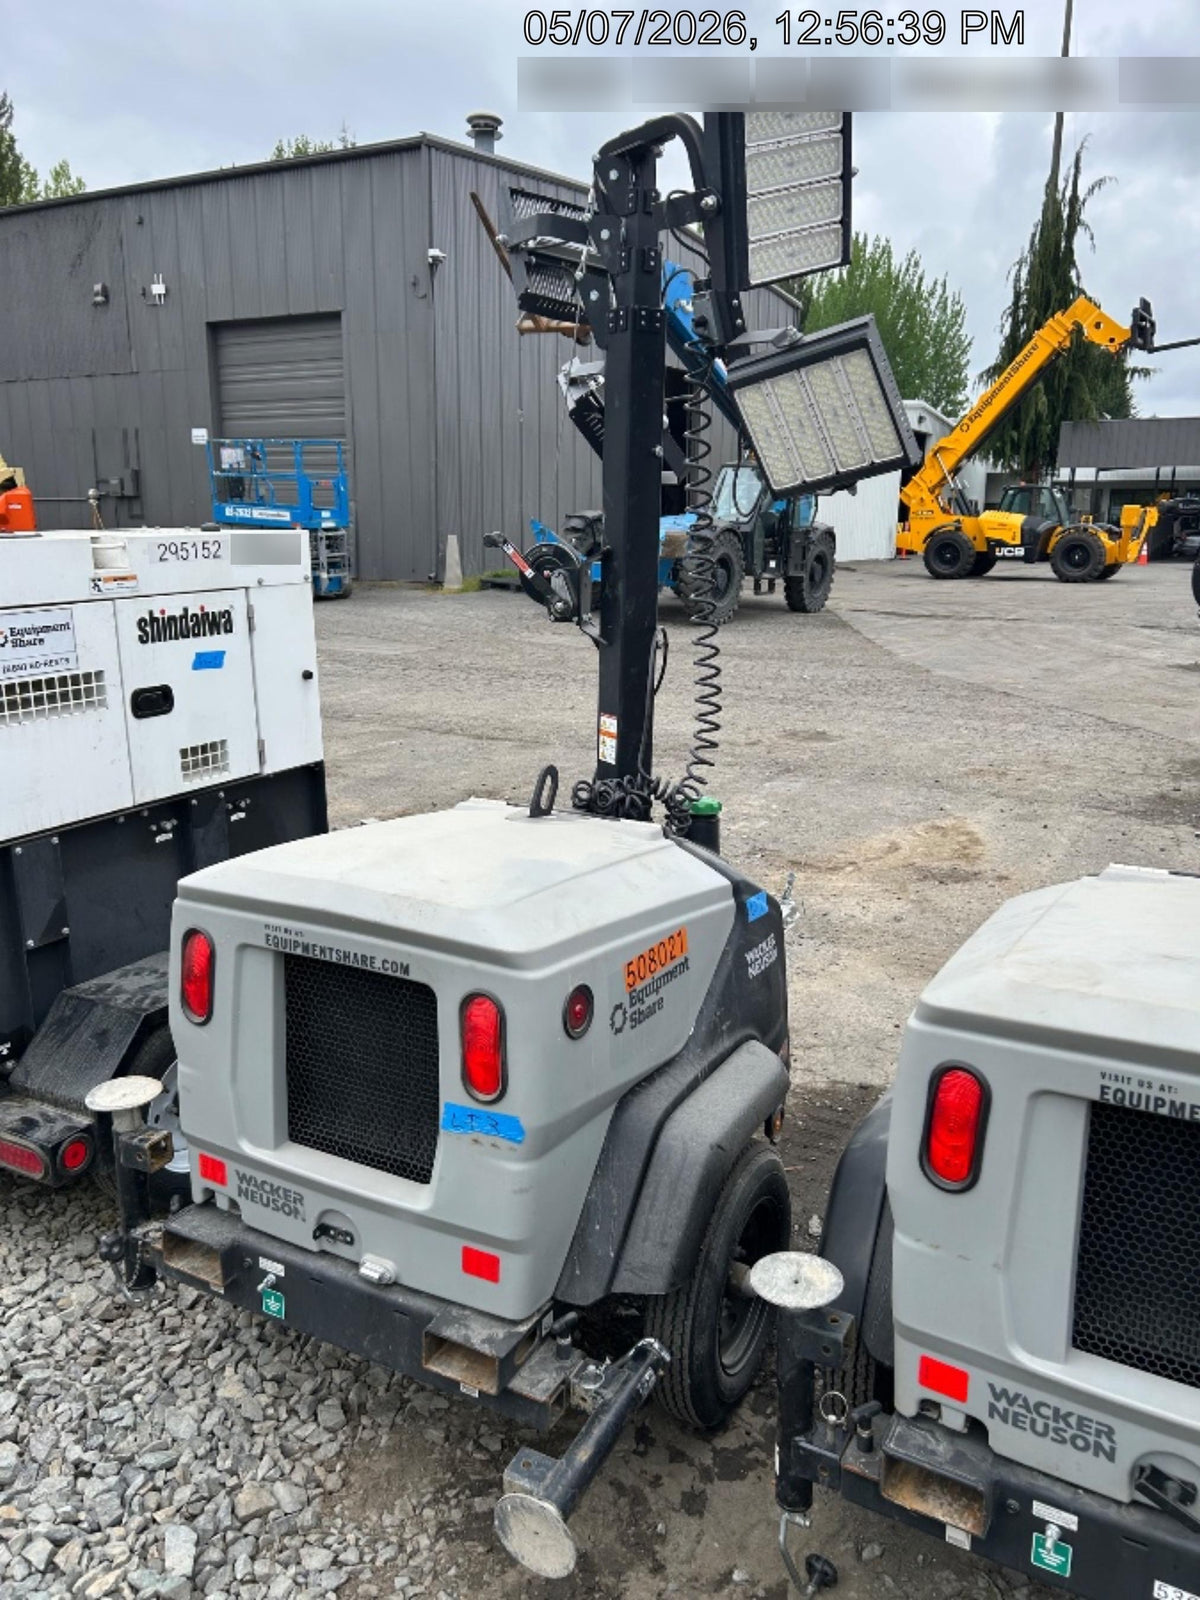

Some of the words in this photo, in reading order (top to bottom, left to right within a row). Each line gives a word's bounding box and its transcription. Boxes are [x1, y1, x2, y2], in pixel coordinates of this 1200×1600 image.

[157, 540, 222, 562] 295152
[995, 546, 1025, 557] JCB
[8, 622, 71, 637] Equipment
[11, 638, 45, 648] Share
[137, 604, 234, 644] shindaiwa
[265, 933, 410, 976] EQUIPMENTSHARE.COM
[629, 956, 690, 1009] Equipment
[629, 997, 664, 1030] Share
[1100, 1071, 1132, 1085] VISIT
[1137, 1079, 1153, 1090] US
[235, 1169, 304, 1207] WACKER
[237, 1184, 306, 1223] NEUSON
[988, 1381, 1117, 1444] WACKER
[988, 1400, 1117, 1464] NEUSON
